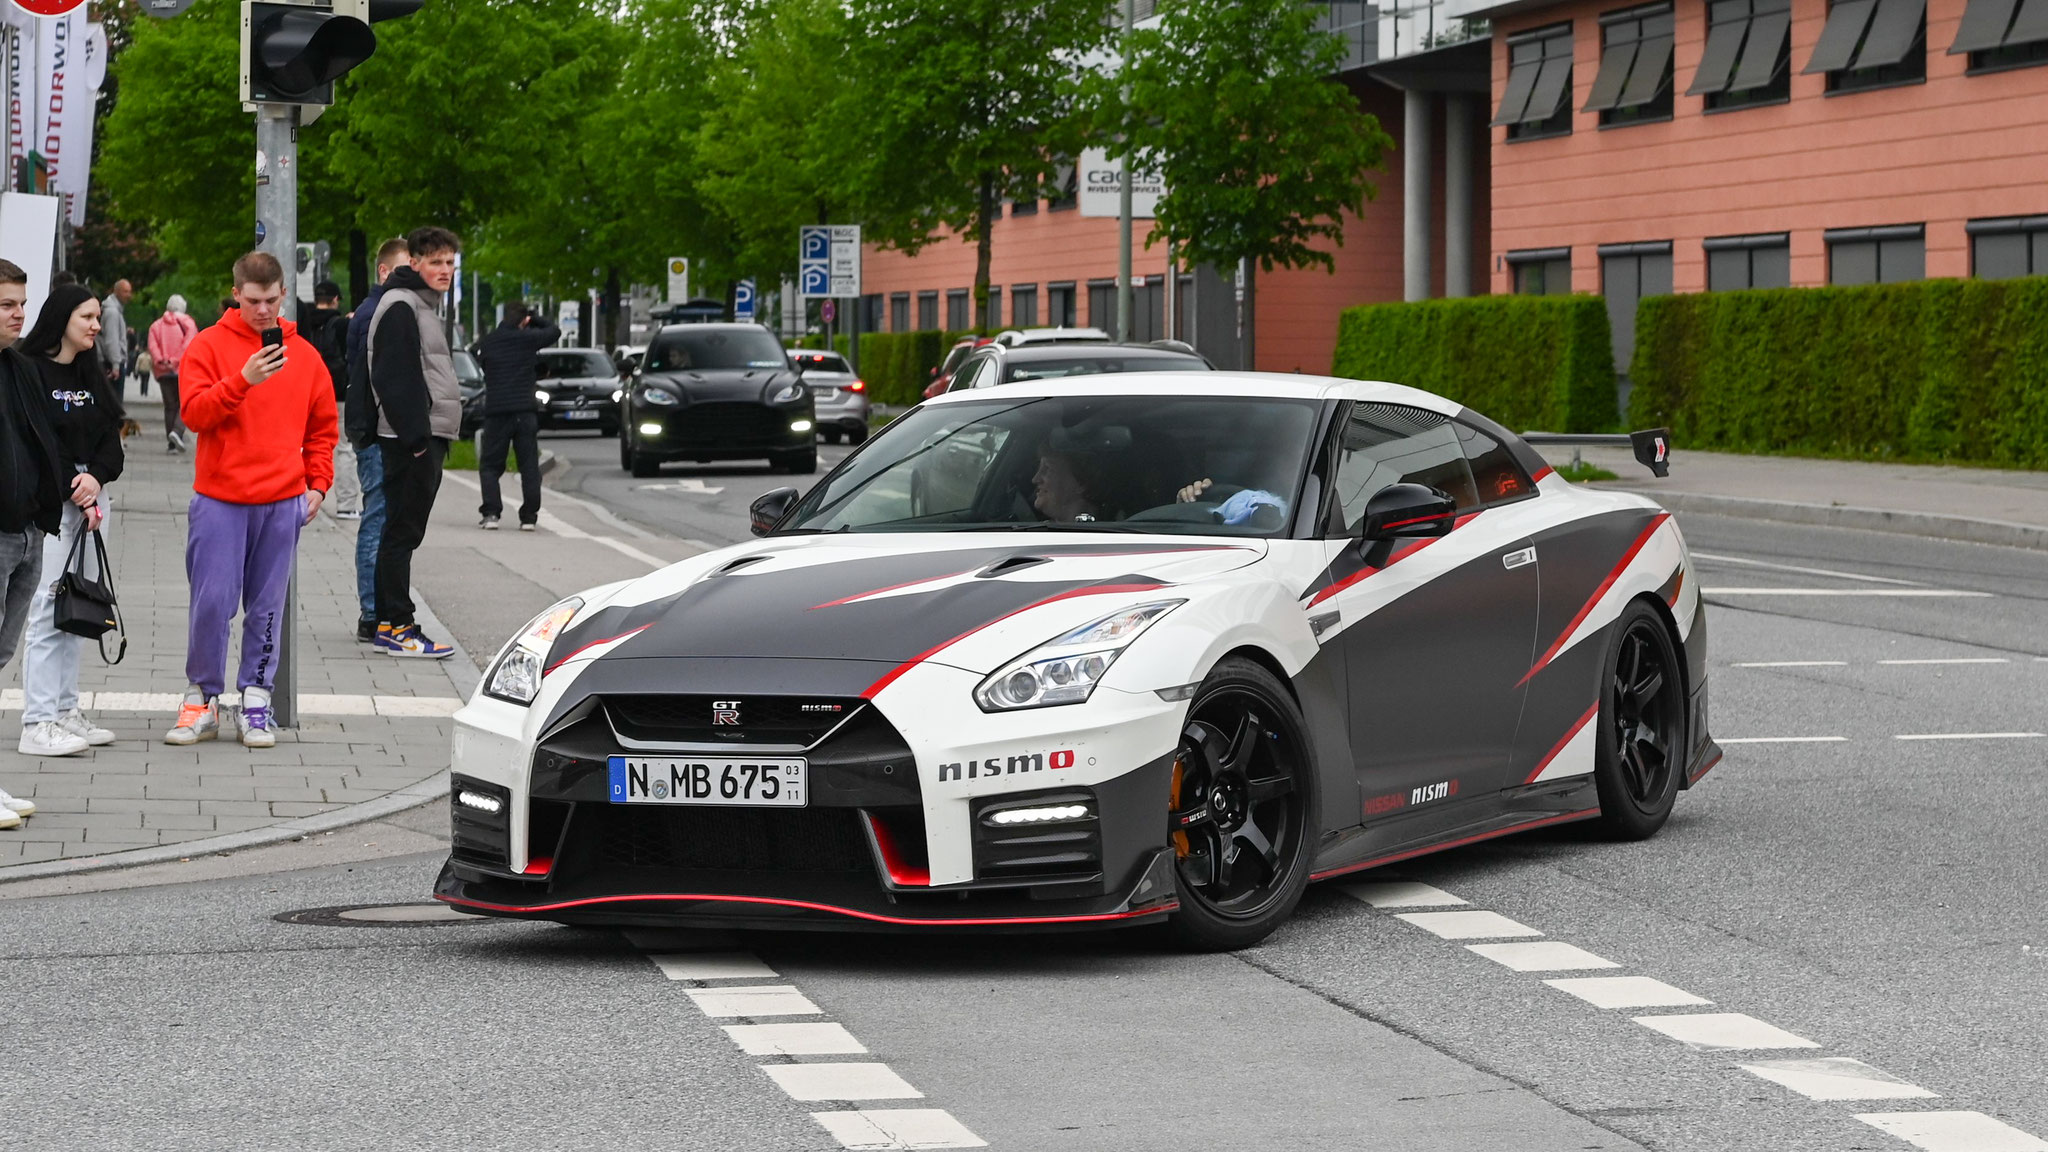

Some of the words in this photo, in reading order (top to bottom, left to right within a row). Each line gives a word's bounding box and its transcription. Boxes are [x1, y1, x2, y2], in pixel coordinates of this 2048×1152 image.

[806, 238, 822, 258] P
[806, 273, 822, 293] P
[712, 701, 742, 710] GT
[712, 709, 742, 725] R
[785, 765, 800, 776] 03
[628, 762, 649, 797] N
[670, 763, 712, 799] MB
[719, 764, 781, 800] 675
[614, 784, 622, 795] D
[787, 789, 800, 801] 11
[1364, 792, 1406, 816] NISSAN
